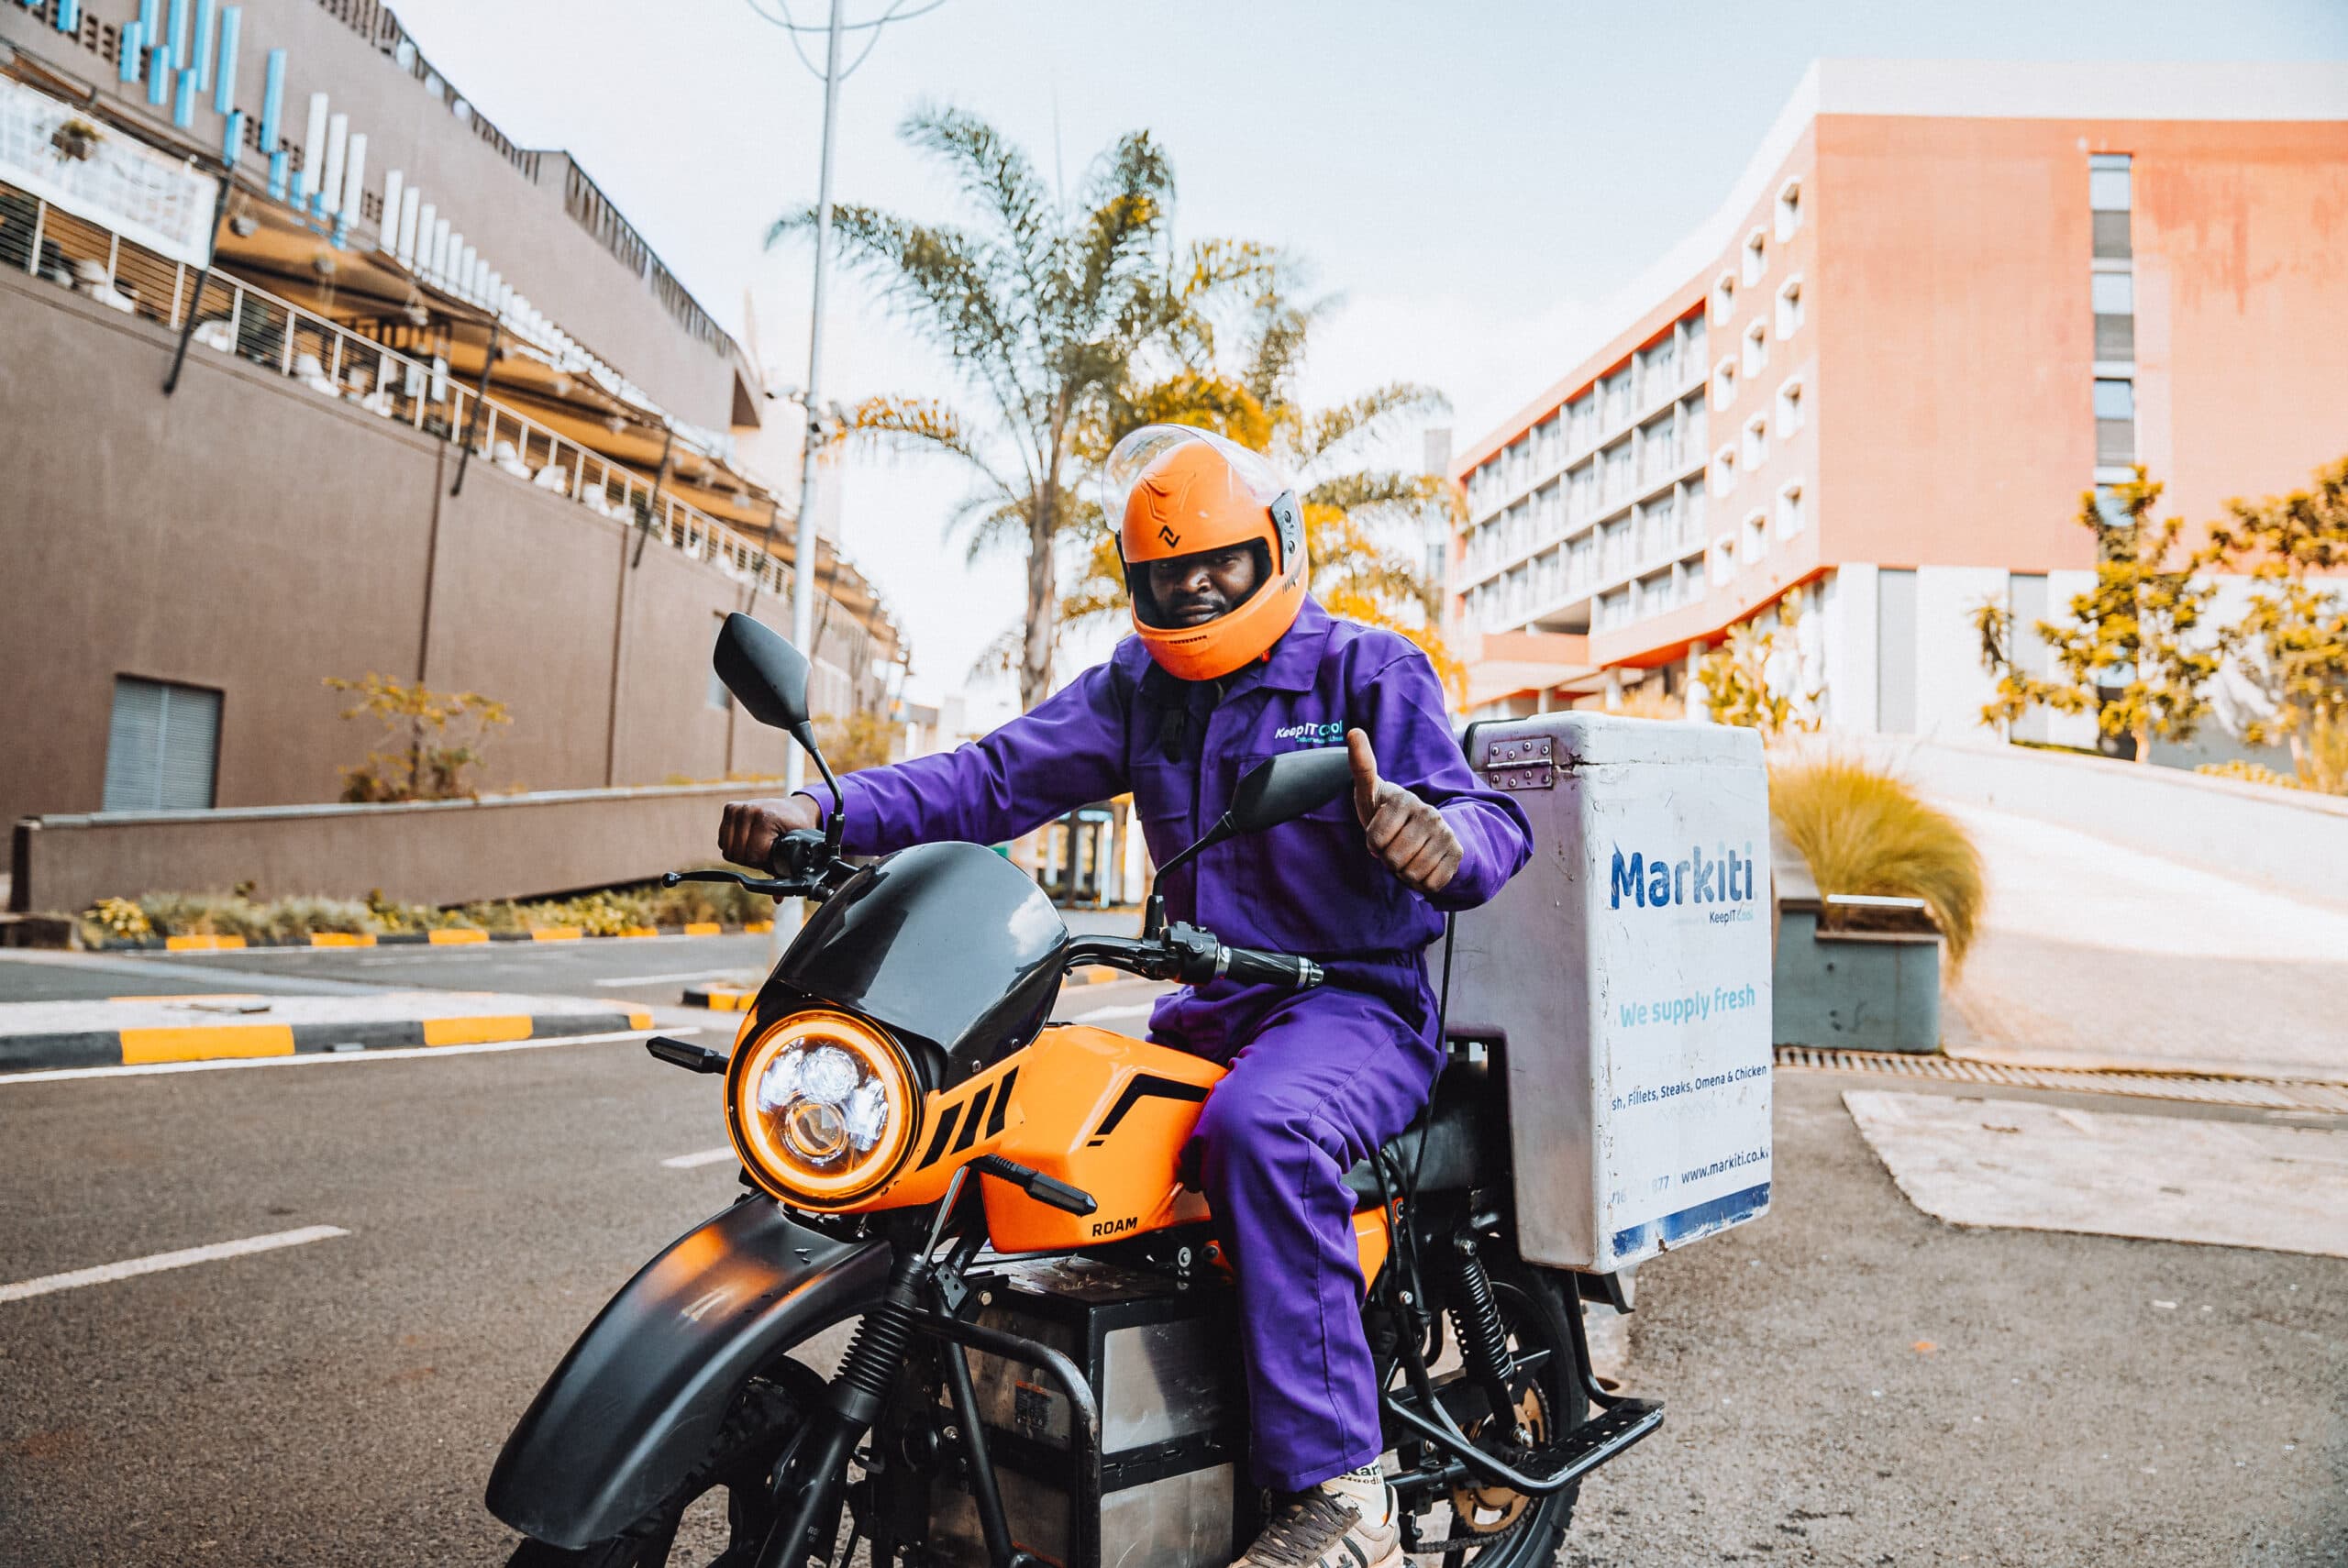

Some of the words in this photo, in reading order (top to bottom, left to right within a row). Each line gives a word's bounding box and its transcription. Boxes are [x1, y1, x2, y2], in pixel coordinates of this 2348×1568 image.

[1611, 841, 1753, 910] Markiti
[1620, 1002, 1647, 1027] We
[1652, 990, 1711, 1025] supply
[1628, 1089, 1659, 1106] Fillets,
[1661, 1081, 1693, 1099] Steaks,
[1695, 1074, 1725, 1089] Omena
[1727, 1071, 1733, 1082] &
[1735, 1065, 1767, 1081] Chicken
[1092, 1217, 1137, 1237] ROAM
